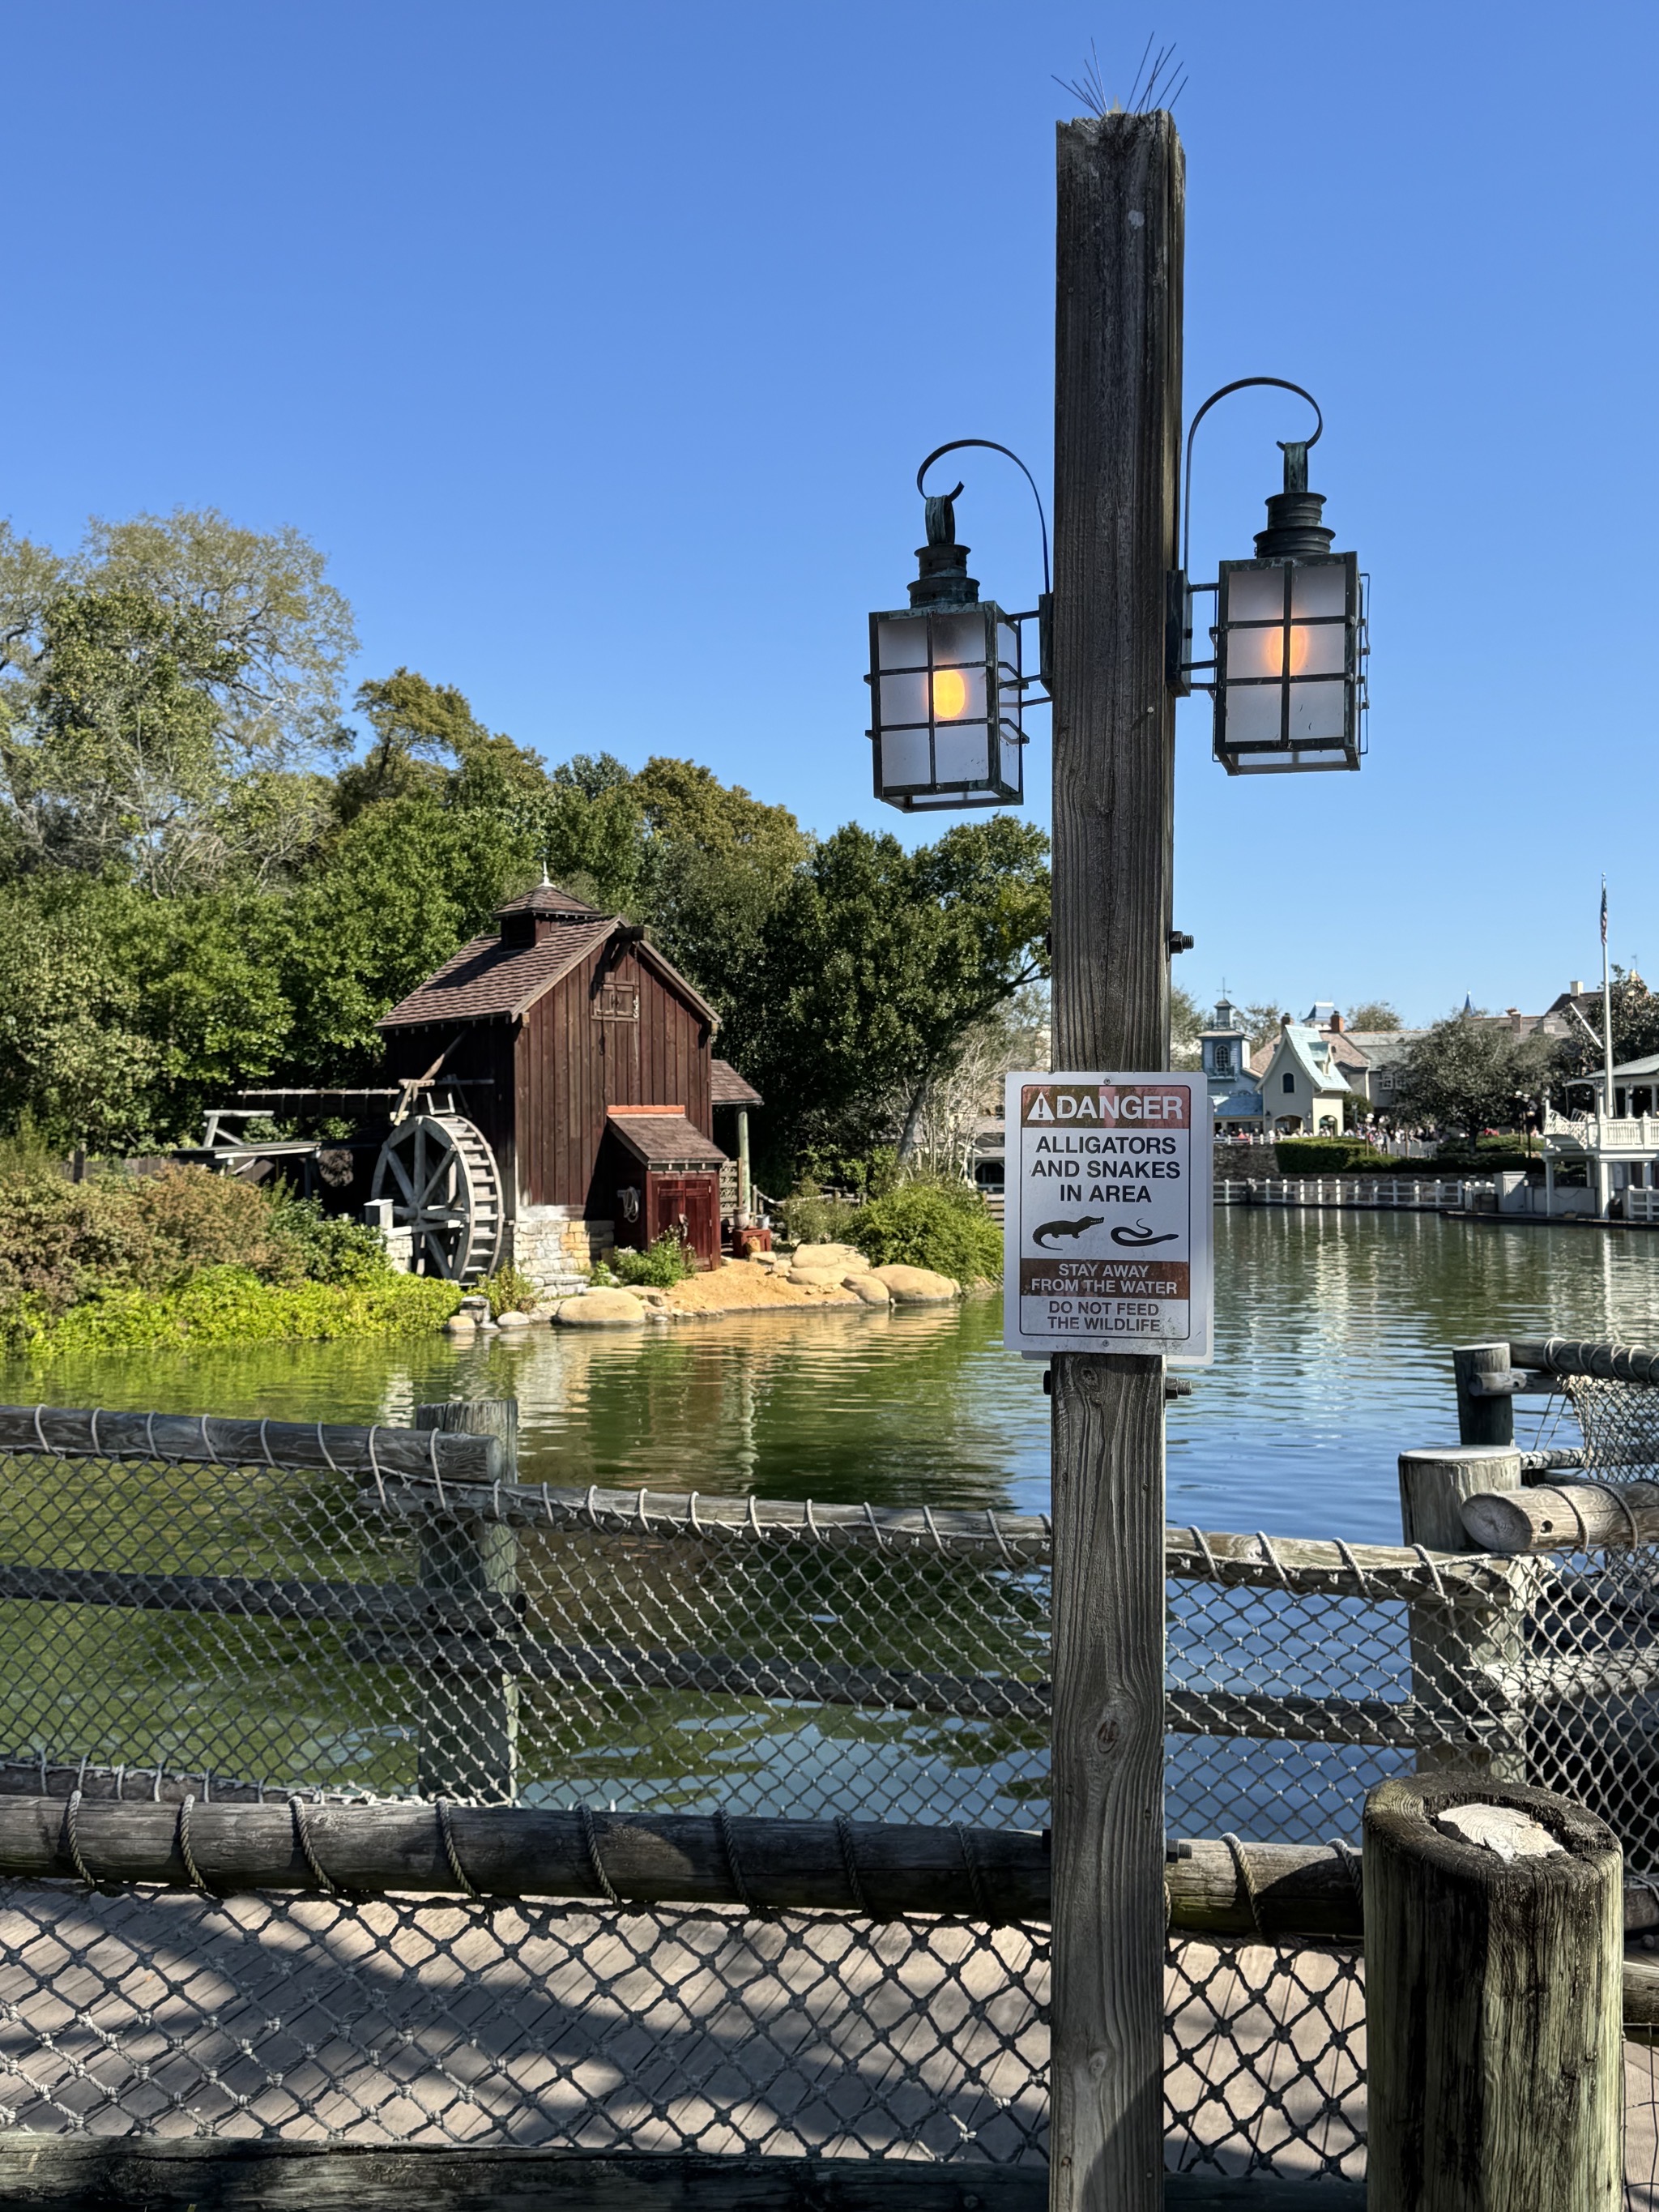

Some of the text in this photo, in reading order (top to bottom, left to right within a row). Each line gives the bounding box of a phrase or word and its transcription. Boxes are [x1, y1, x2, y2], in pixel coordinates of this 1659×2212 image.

[1056, 1095, 1183, 1120] DANGER
[1035, 1136, 1176, 1155] ALLIGATORS
[1031, 1160, 1180, 1179] AND SNAKES
[1060, 1185, 1152, 1203] IN AREA
[1059, 1263, 1149, 1278] STAY AWAY
[1031, 1278, 1177, 1295] FROM THE WATER
[1049, 1301, 1159, 1317] DO NOT FEED
[1047, 1317, 1160, 1332] THE WILDLIFE
